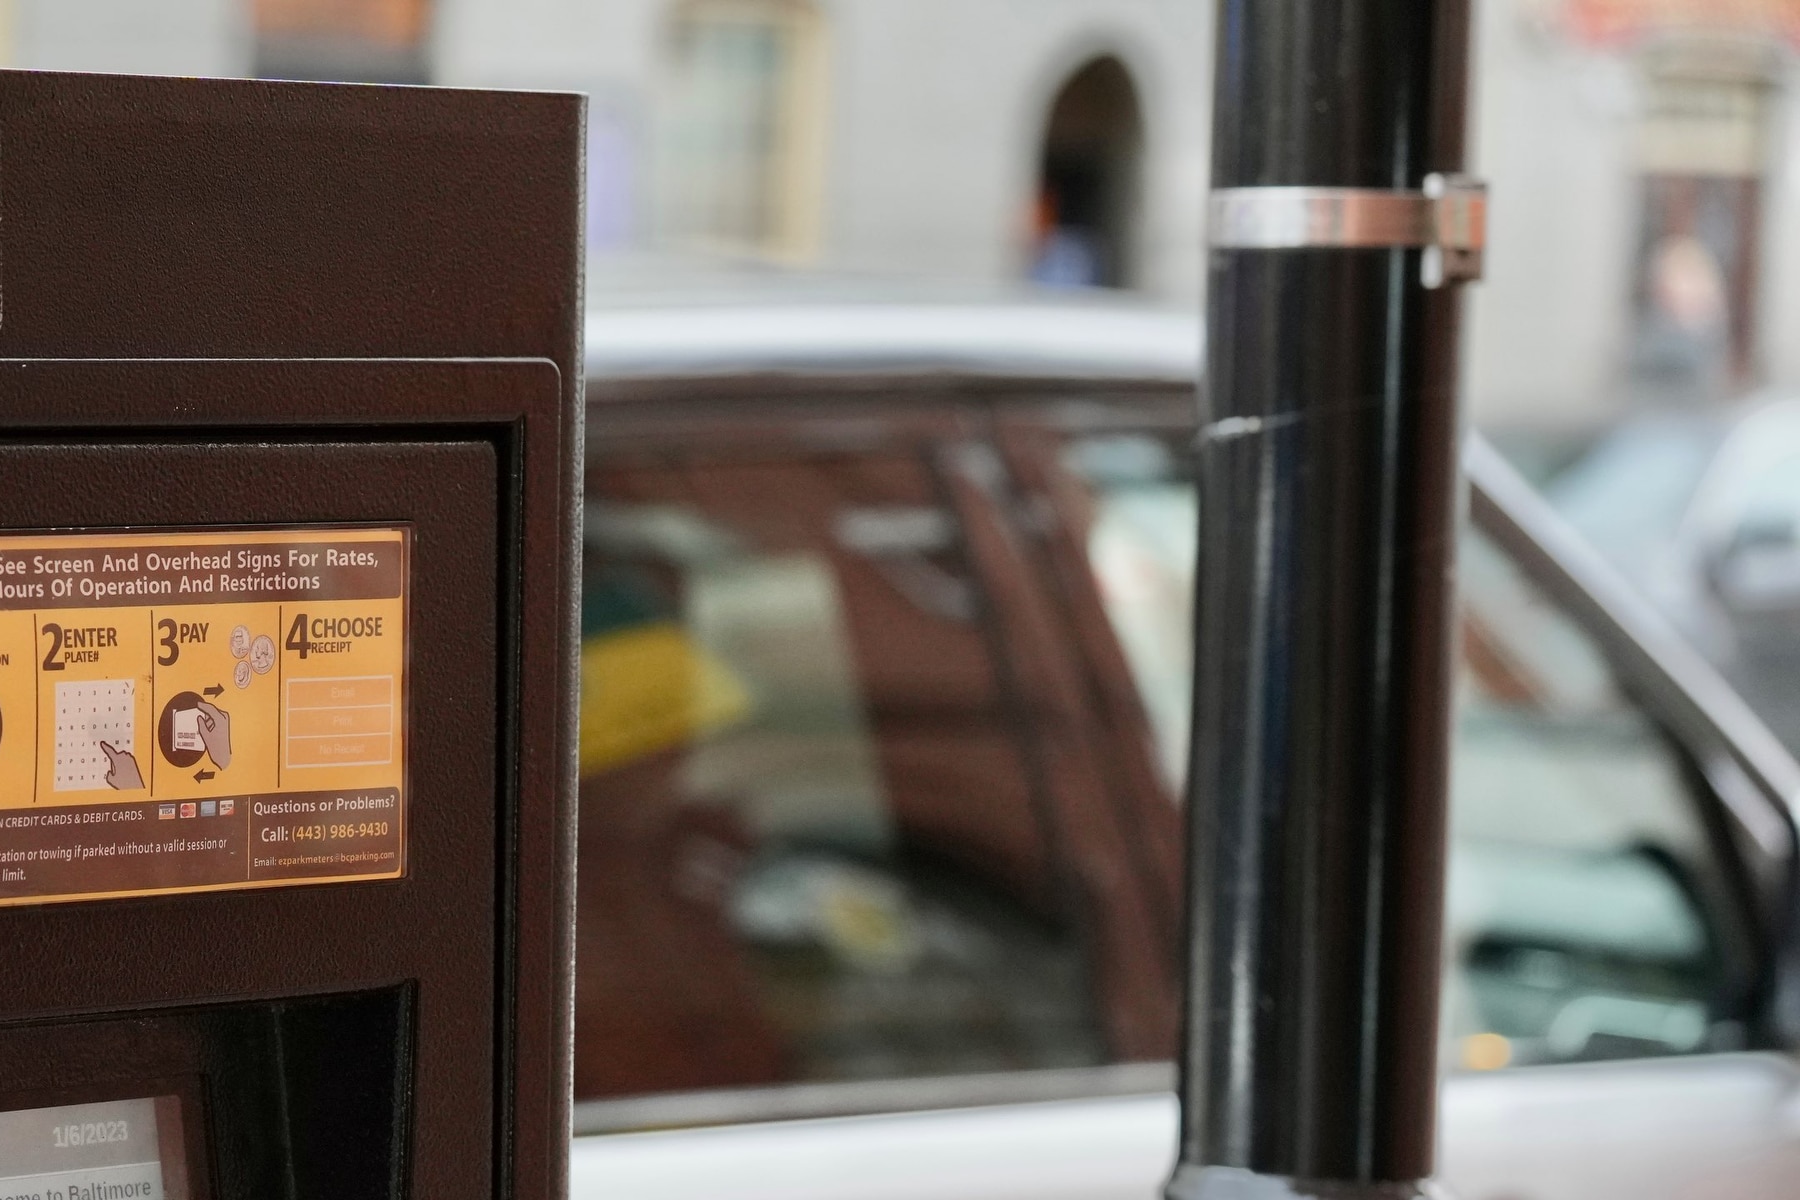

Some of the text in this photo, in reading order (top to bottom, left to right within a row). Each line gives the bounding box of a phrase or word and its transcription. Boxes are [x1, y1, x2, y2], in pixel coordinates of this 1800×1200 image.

[33, 555, 95, 574] Screen
[102, 553, 139, 573] And
[146, 551, 231, 571] Overhead
[237, 550, 281, 573] Signs
[288, 550, 319, 567] For
[326, 549, 379, 568] Rates,
[51, 577, 73, 597] Of
[80, 576, 172, 600] Operation
[179, 575, 213, 593] And
[219, 572, 320, 592] Restrictions
[41, 623, 118, 671] 2 ENTER
[157, 618, 210, 666] 3 PAY
[285, 613, 383, 659] 4 CHOOSE
[311, 641, 352, 654] RECEIPT
[64, 651, 99, 664] PLATE#
[253, 795, 395, 816] Questions or Problems?
[5, 816, 38, 828] CREDIT
[41, 814, 72, 826] CARDS
[75, 814, 81, 824] &
[83, 812, 110, 823] DEBIT
[111, 810, 145, 822] CARDS.
[261, 821, 388, 843] Call: (443) 986-9430
[27, 850, 38, 861] or
[39, 845, 72, 862] towing
[74, 845, 82, 858] if
[83, 843, 116, 860] parked
[118, 841, 153, 855] without
[155, 844, 161, 852] a
[163, 838, 185, 852] valid
[187, 837, 217, 851] session
[218, 838, 227, 849] or
[254, 857, 277, 867] Email:
[2, 868, 26, 882] limit.
[52, 1120, 129, 1148] 1/6/2023
